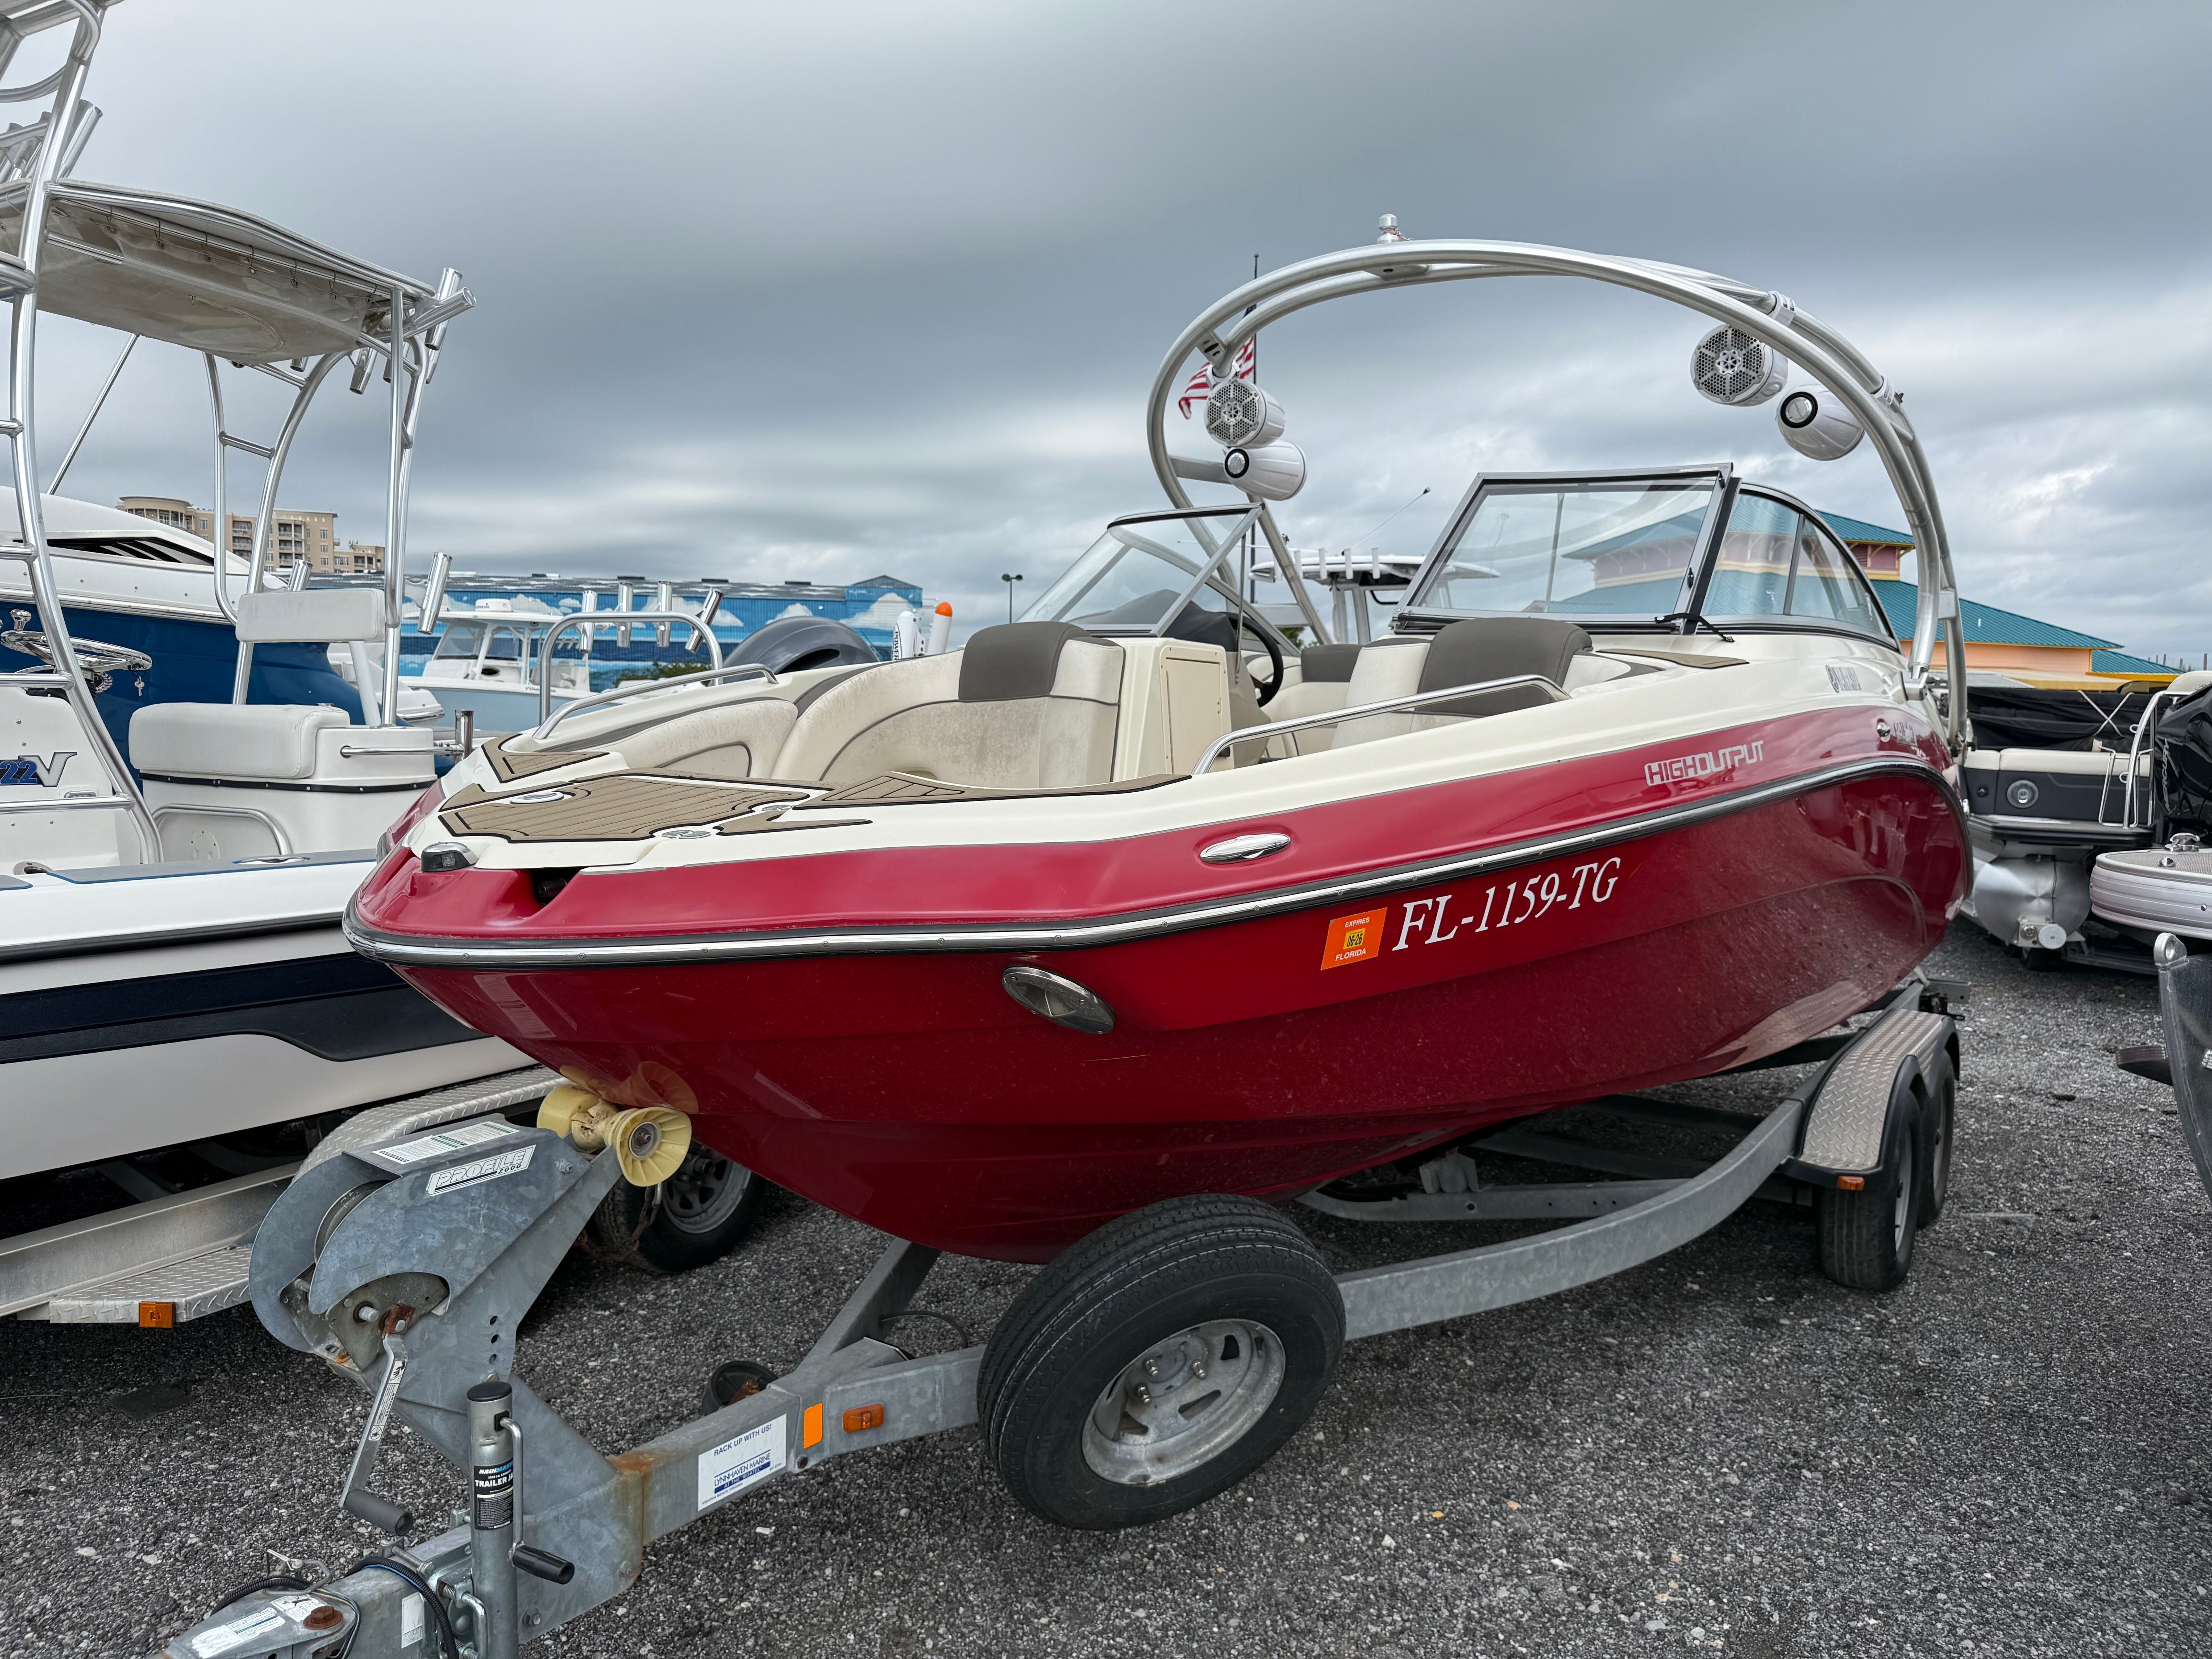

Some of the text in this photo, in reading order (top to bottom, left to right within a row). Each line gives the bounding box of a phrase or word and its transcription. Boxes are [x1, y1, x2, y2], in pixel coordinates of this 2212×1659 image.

[1392, 857, 1621, 951] FL-1159-TG
[1345, 917, 1370, 928] EXPIRES
[1347, 933, 1363, 947] 06-26
[1335, 948, 1366, 961] FLORIDA
[436, 1151, 526, 1187] PROFILE
[498, 1164, 521, 1174] 2000
[714, 1424, 772, 1456] RACK UP WITH US!
[714, 1464, 748, 1486] LYNNHAVEN
[749, 1453, 771, 1469] MARINE
[475, 1476, 507, 1487] TRAILER
